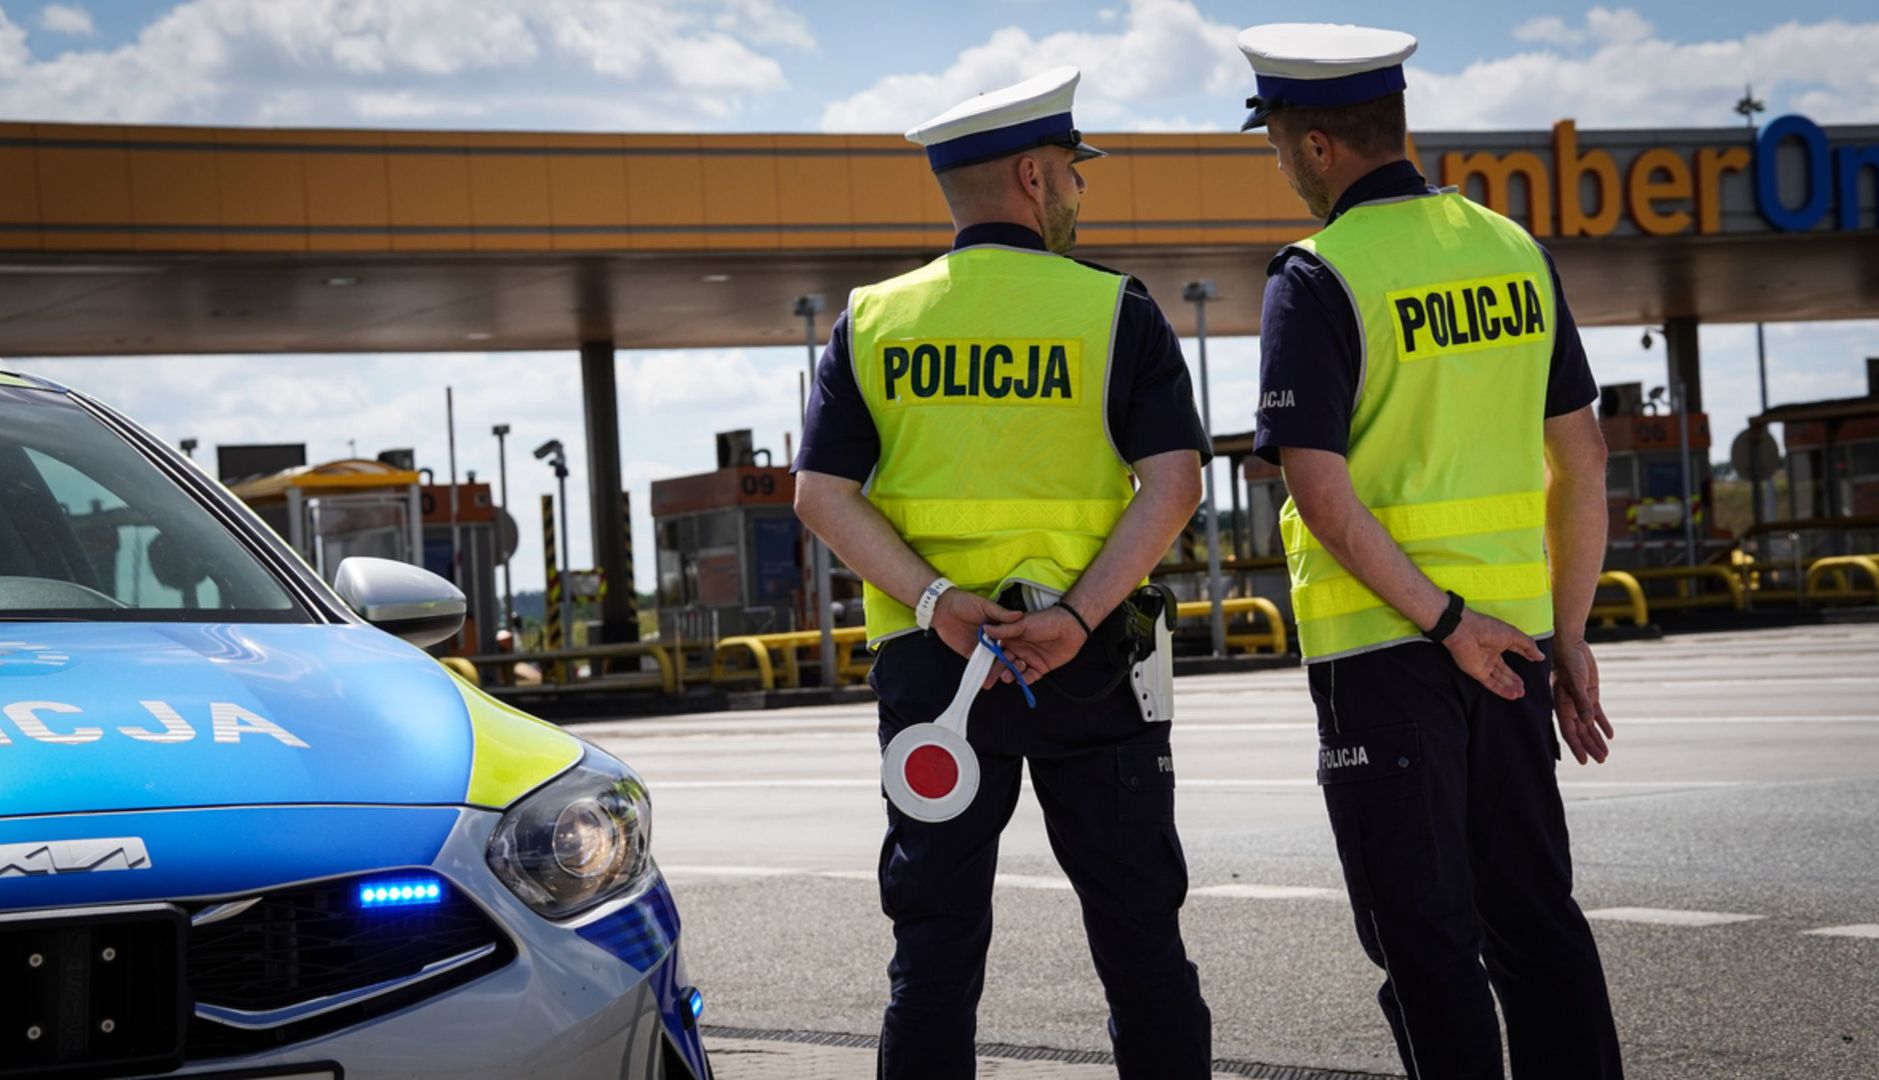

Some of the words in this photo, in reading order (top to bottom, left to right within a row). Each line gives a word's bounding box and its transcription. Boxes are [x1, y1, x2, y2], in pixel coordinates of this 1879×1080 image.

[1405, 114, 1879, 238] mberOn
[1394, 279, 1545, 353] POLICJA
[883, 343, 1073, 401] POLICJA
[1257, 389, 1296, 409] ICJA
[741, 474, 775, 496] 09
[0, 699, 311, 749] CJA
[1320, 745, 1370, 769] POLICJA
